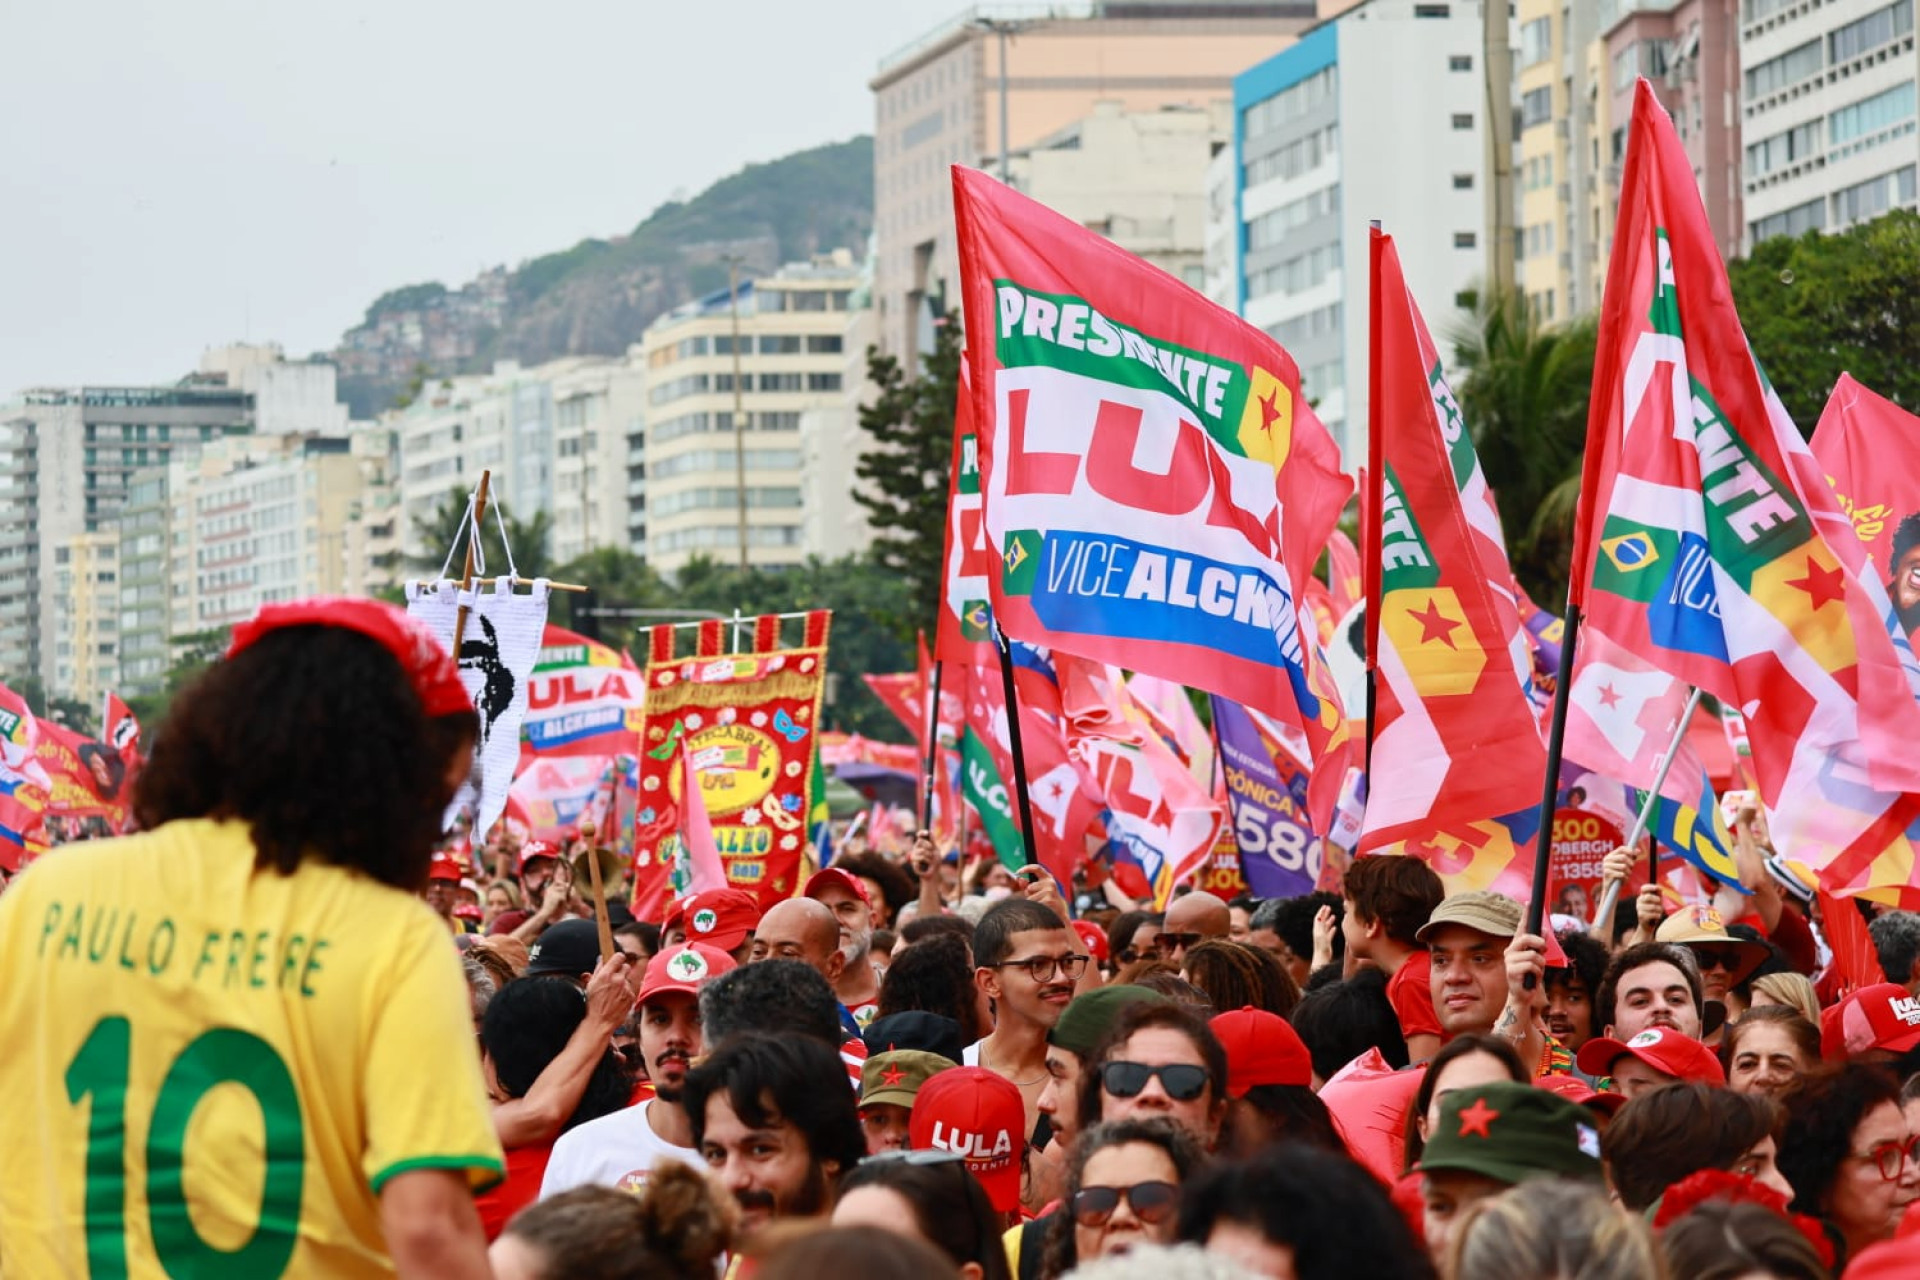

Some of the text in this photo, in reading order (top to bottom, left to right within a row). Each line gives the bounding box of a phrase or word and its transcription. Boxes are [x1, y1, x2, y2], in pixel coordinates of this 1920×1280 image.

[997, 286, 1232, 419] PRESDNTE
[1005, 388, 1285, 566] LUL
[1047, 538, 1130, 598] VICE
[527, 673, 632, 710] ULA
[1229, 795, 1322, 882] 58
[38, 901, 178, 976] PAULO
[65, 1014, 304, 1280] 10
[931, 1120, 1011, 1157] LULA
